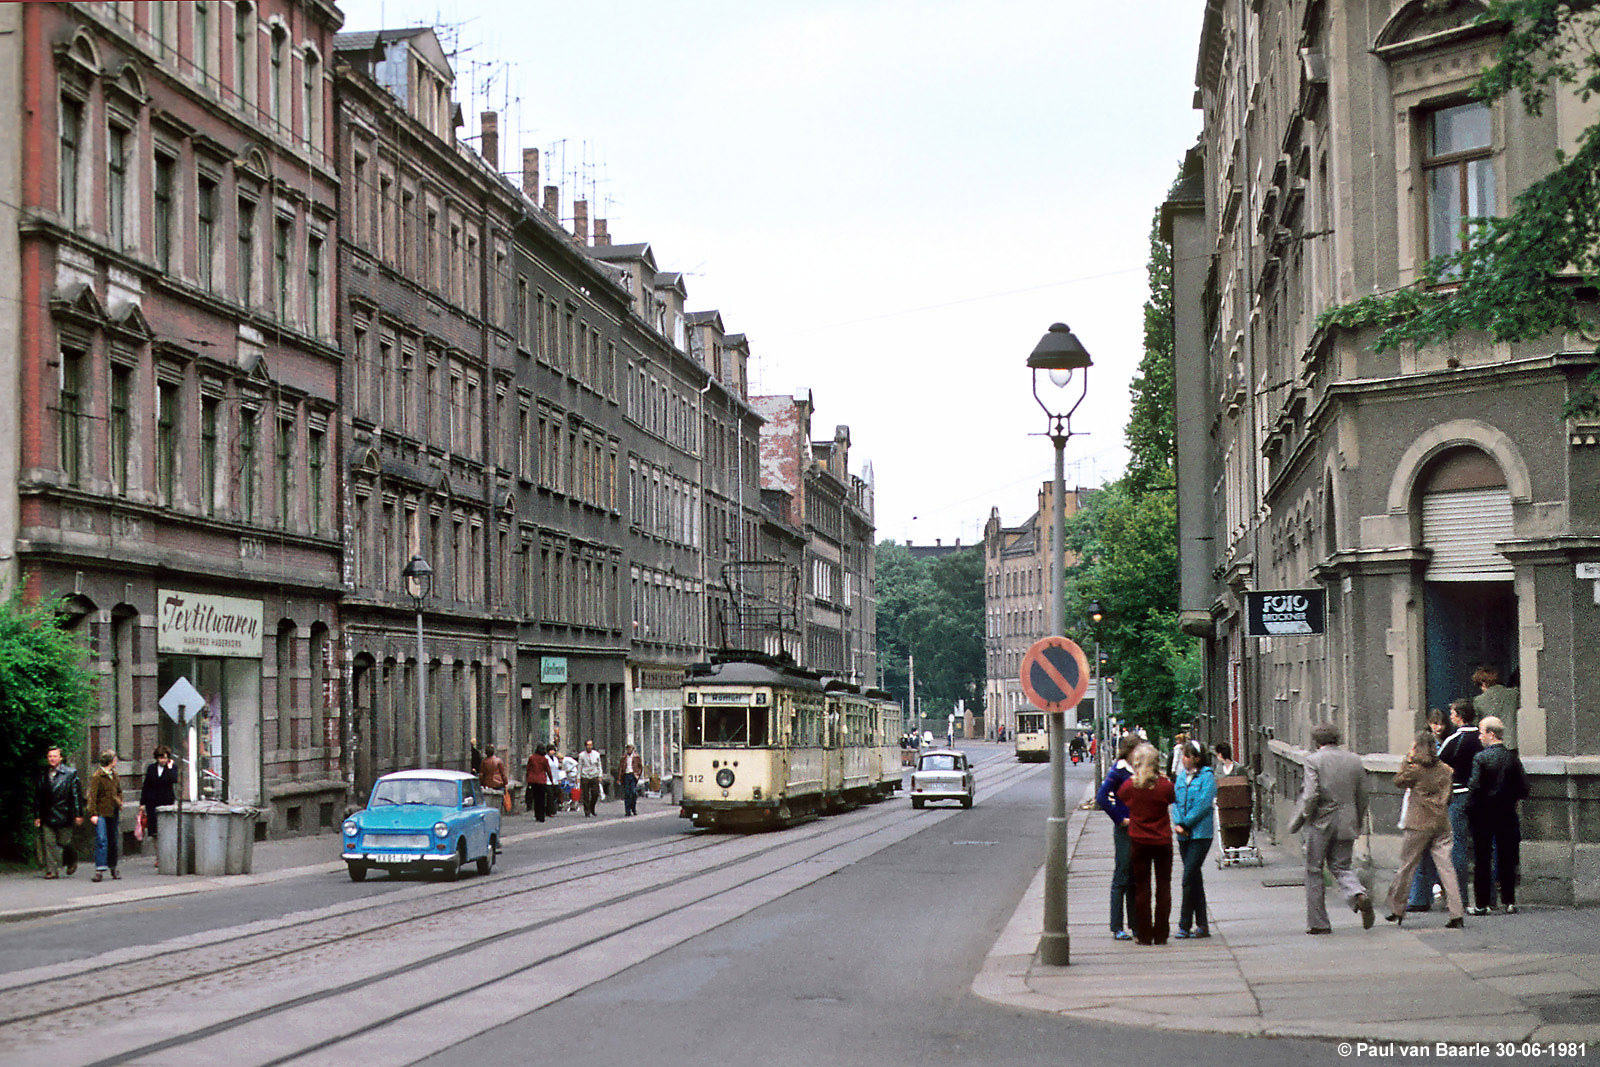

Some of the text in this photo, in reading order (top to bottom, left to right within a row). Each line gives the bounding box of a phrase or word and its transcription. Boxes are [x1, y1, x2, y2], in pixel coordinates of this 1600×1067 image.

[1262, 595, 1309, 612] FOTO
[162, 595, 257, 639] Textilwaren
[757, 693, 766, 704] 3
[688, 774, 704, 783] 312
